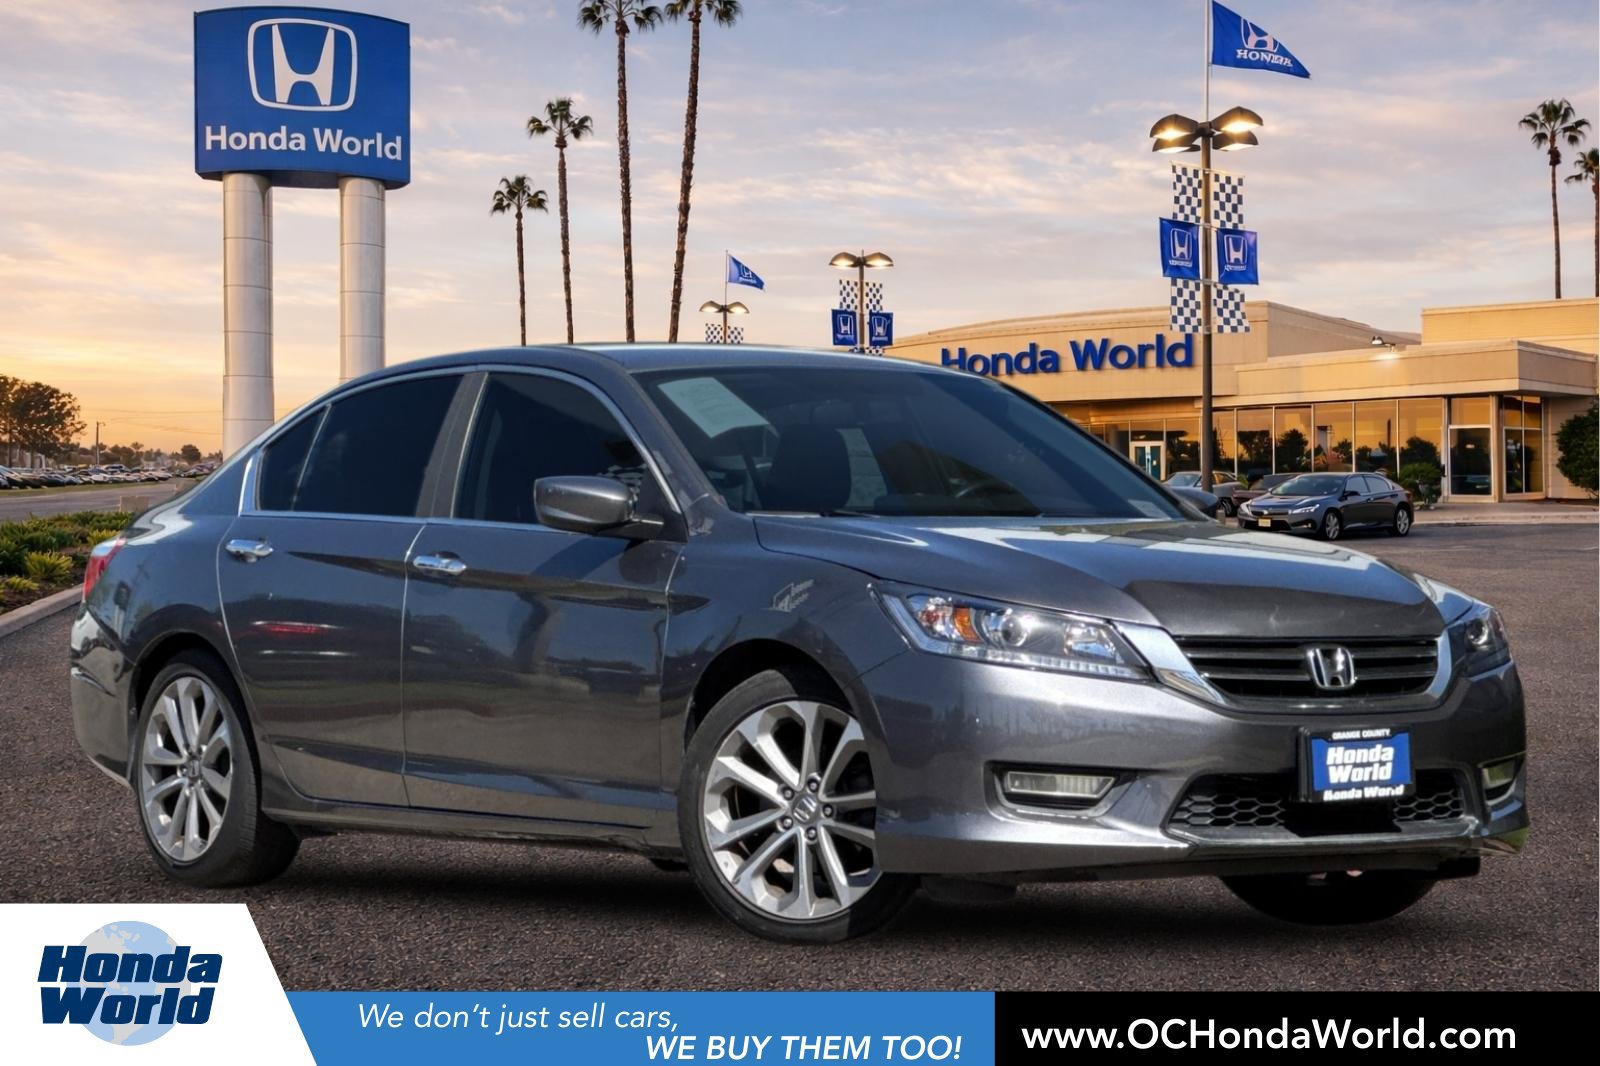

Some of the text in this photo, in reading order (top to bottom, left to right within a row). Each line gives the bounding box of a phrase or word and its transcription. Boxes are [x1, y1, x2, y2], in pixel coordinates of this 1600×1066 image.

[205, 125, 402, 161] Honda World
[941, 333, 1194, 377] Honda World
[1331, 728, 1391, 740] ORANGE COUNTY
[1326, 744, 1394, 765] Honda
[1328, 762, 1393, 784] World
[1323, 784, 1405, 801] Honda World
